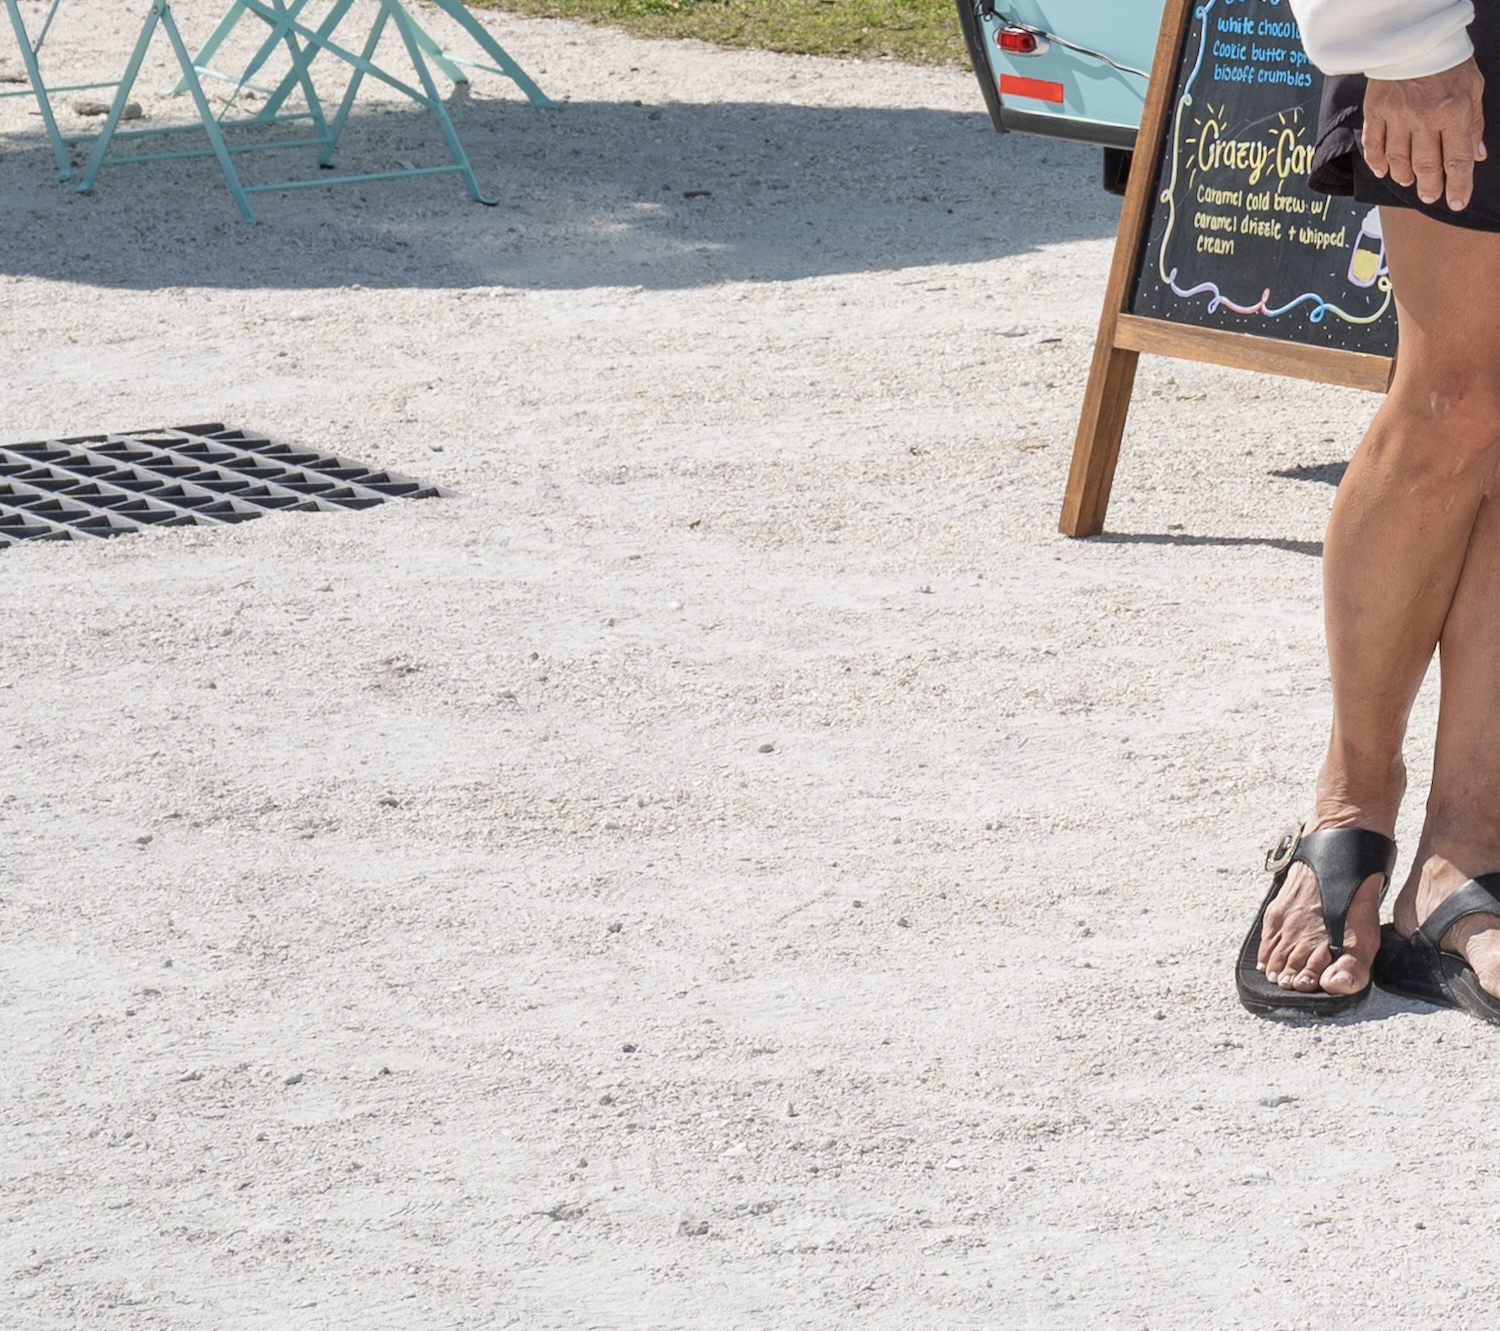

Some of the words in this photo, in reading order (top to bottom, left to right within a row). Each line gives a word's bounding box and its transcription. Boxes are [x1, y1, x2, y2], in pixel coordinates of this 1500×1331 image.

[1218, 17, 1254, 34] white
[1258, 19, 1300, 38] chocol
[1251, 43, 1286, 62] butter
[1290, 50, 1313, 66] spr
[1214, 64, 1255, 82] biscoff
[1258, 67, 1312, 86] crumbles
[1198, 119, 1267, 185] Crazy
[1277, 128, 1315, 178] Car
[1274, 193, 1306, 213] brew
[1311, 195, 1331, 221] w/
[1241, 214, 1281, 240] drizzle
[1299, 226, 1345, 249] whipped
